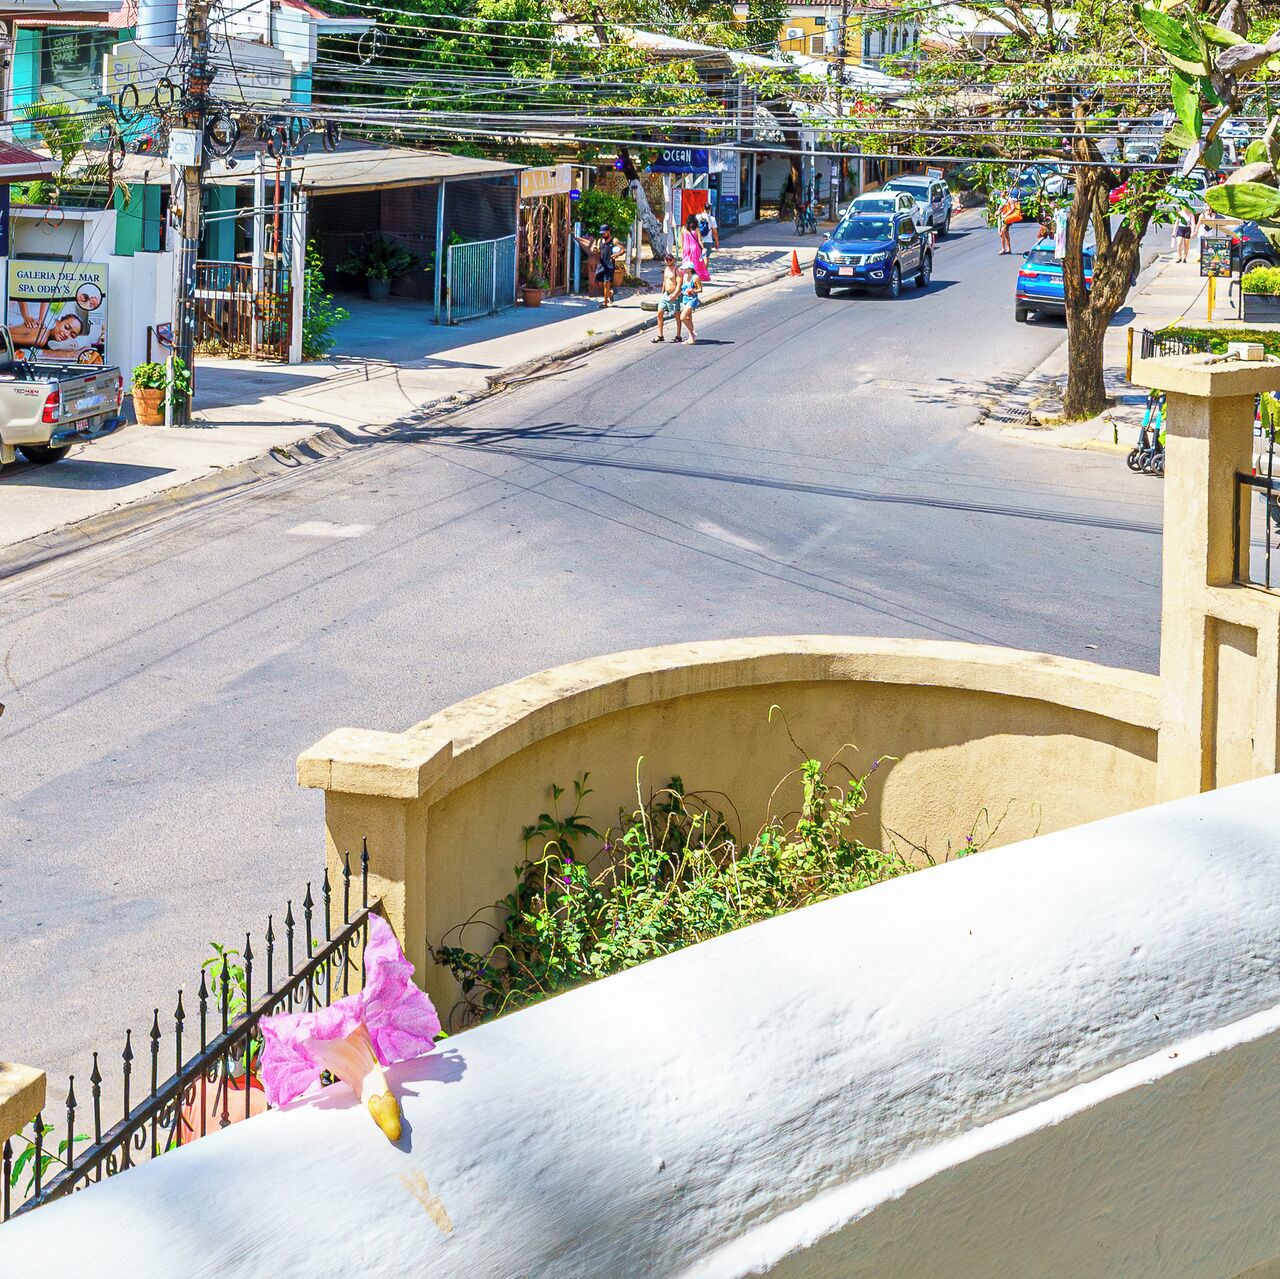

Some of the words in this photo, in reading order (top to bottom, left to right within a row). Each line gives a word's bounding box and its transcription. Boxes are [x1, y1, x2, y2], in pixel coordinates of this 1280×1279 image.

[16, 270, 55, 280] GALERIA
[58, 272, 76, 281] DEL
[78, 273, 100, 282] MAR
[18, 284, 35, 293] SPA
[37, 284, 70, 294] ODRY'S
